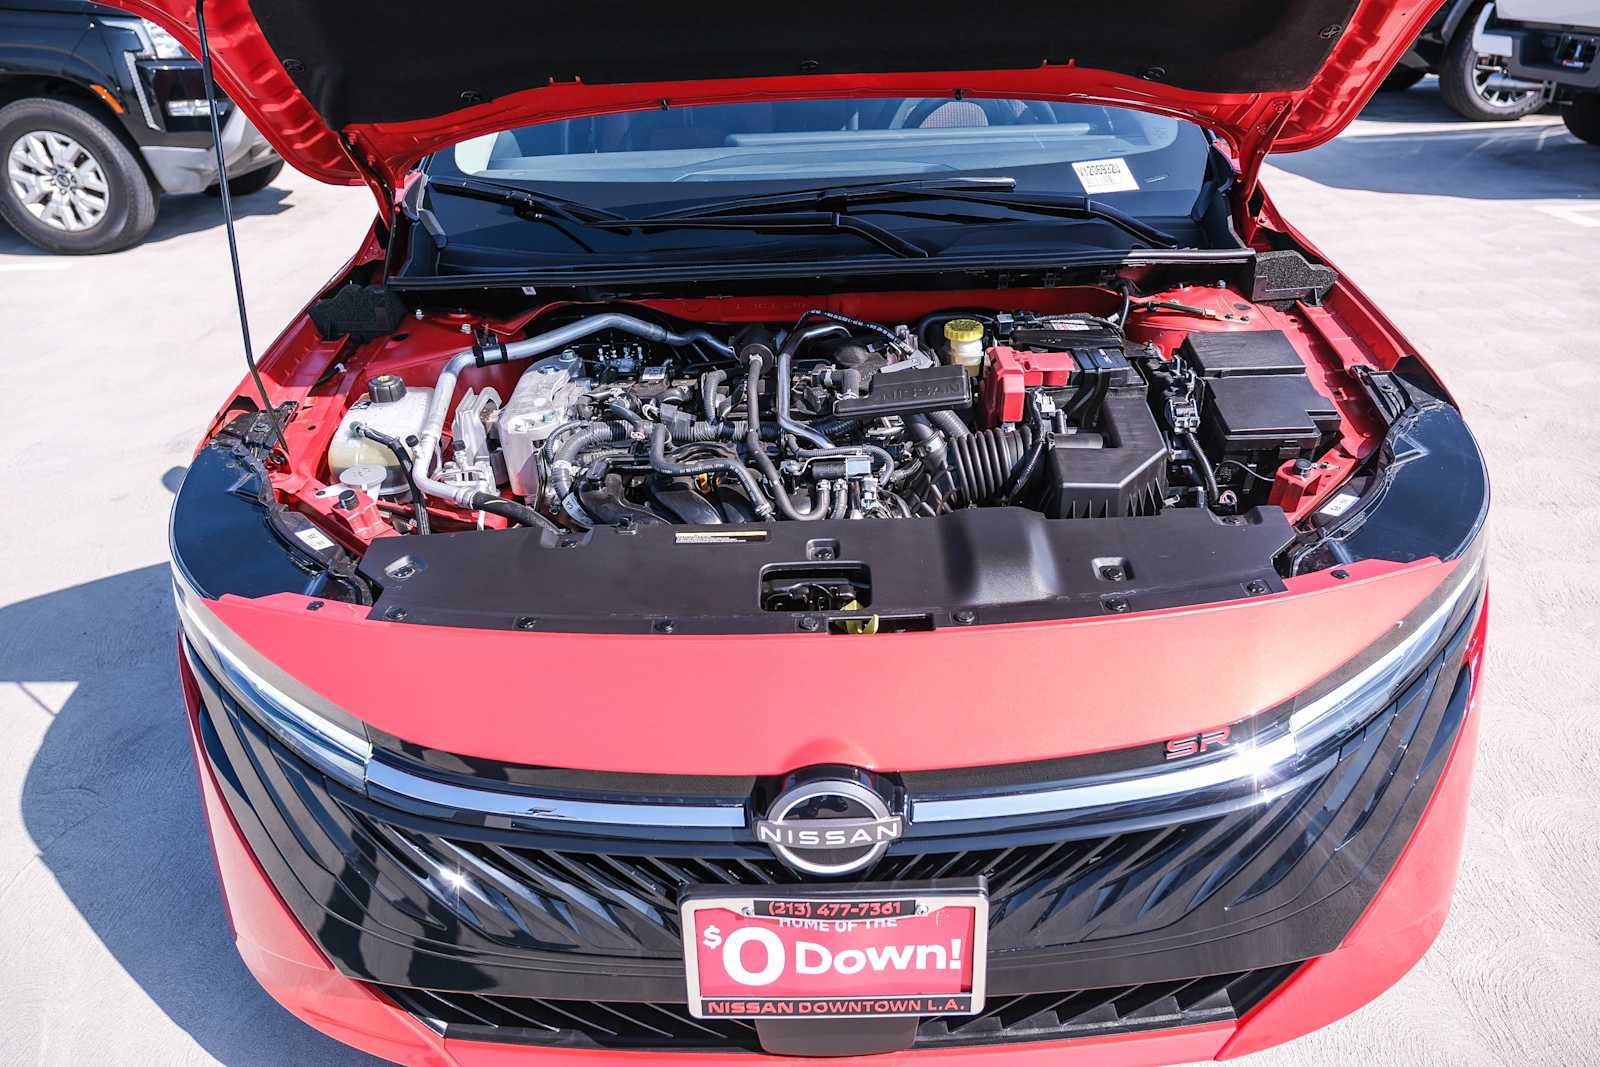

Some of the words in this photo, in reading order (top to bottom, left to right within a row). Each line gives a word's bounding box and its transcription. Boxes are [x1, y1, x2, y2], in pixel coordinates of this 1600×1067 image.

[1166, 727, 1231, 760] SR
[760, 823, 898, 846] NISSAN
[768, 901, 812, 918] (213)
[817, 901, 901, 917] 477-7361
[795, 938, 962, 975] Down!
[707, 1001, 794, 1015] NISSAN
[798, 999, 922, 1014] DOWNTOWN
[927, 998, 966, 1012] L.A.
